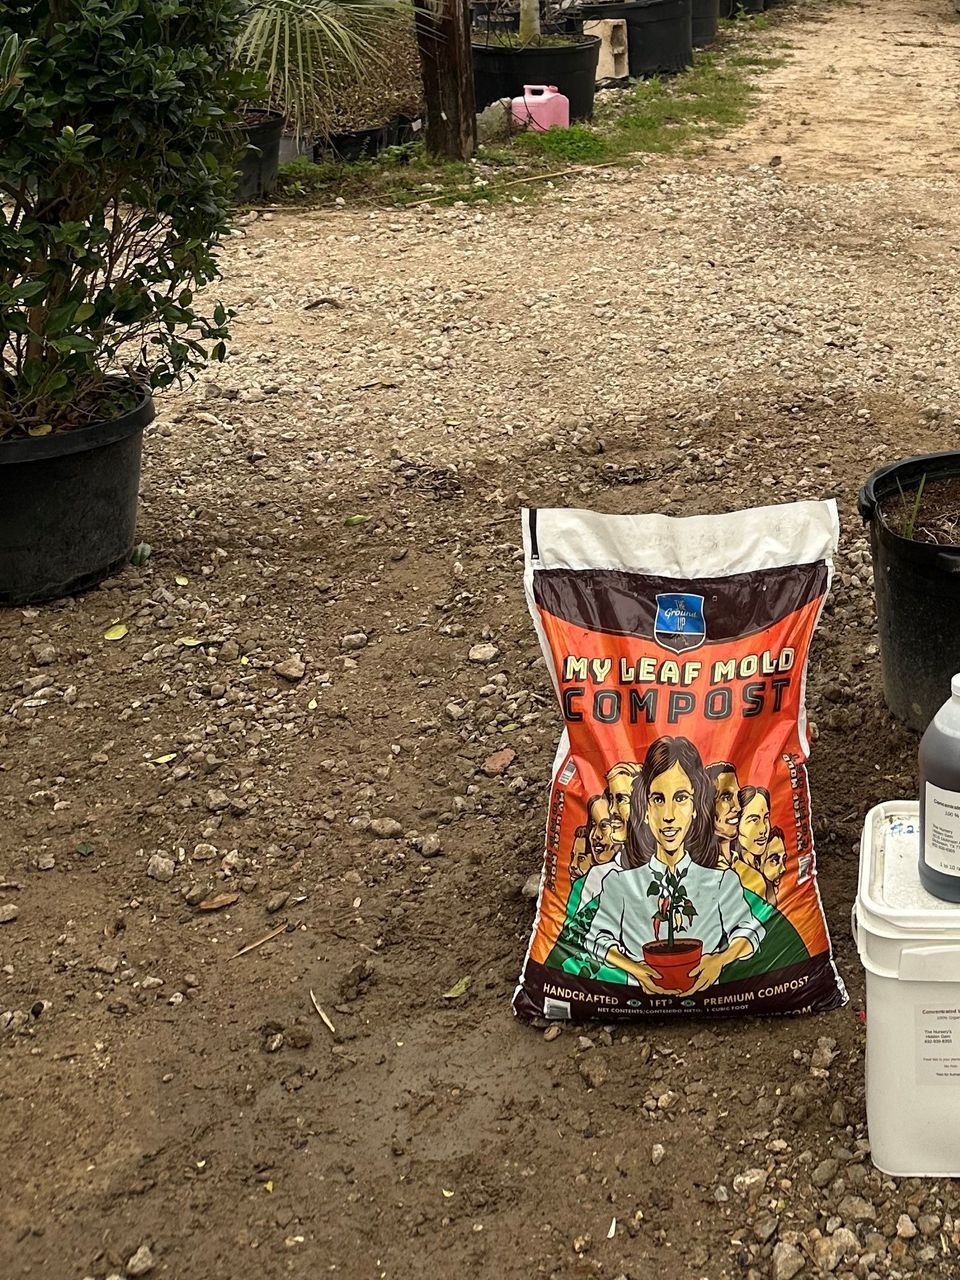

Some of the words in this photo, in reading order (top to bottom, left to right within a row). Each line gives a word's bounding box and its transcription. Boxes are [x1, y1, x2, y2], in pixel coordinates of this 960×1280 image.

[562, 655, 612, 683] MY
[619, 657, 702, 687] LEAF
[710, 647, 795, 686] MOLD
[562, 679, 792, 724] COMPOST
[782, 753, 798, 789] MOLD
[543, 983, 619, 1005] HANDCRAFTED
[704, 992, 755, 1006] PREMIUM
[757, 976, 809, 998] COMPOST
